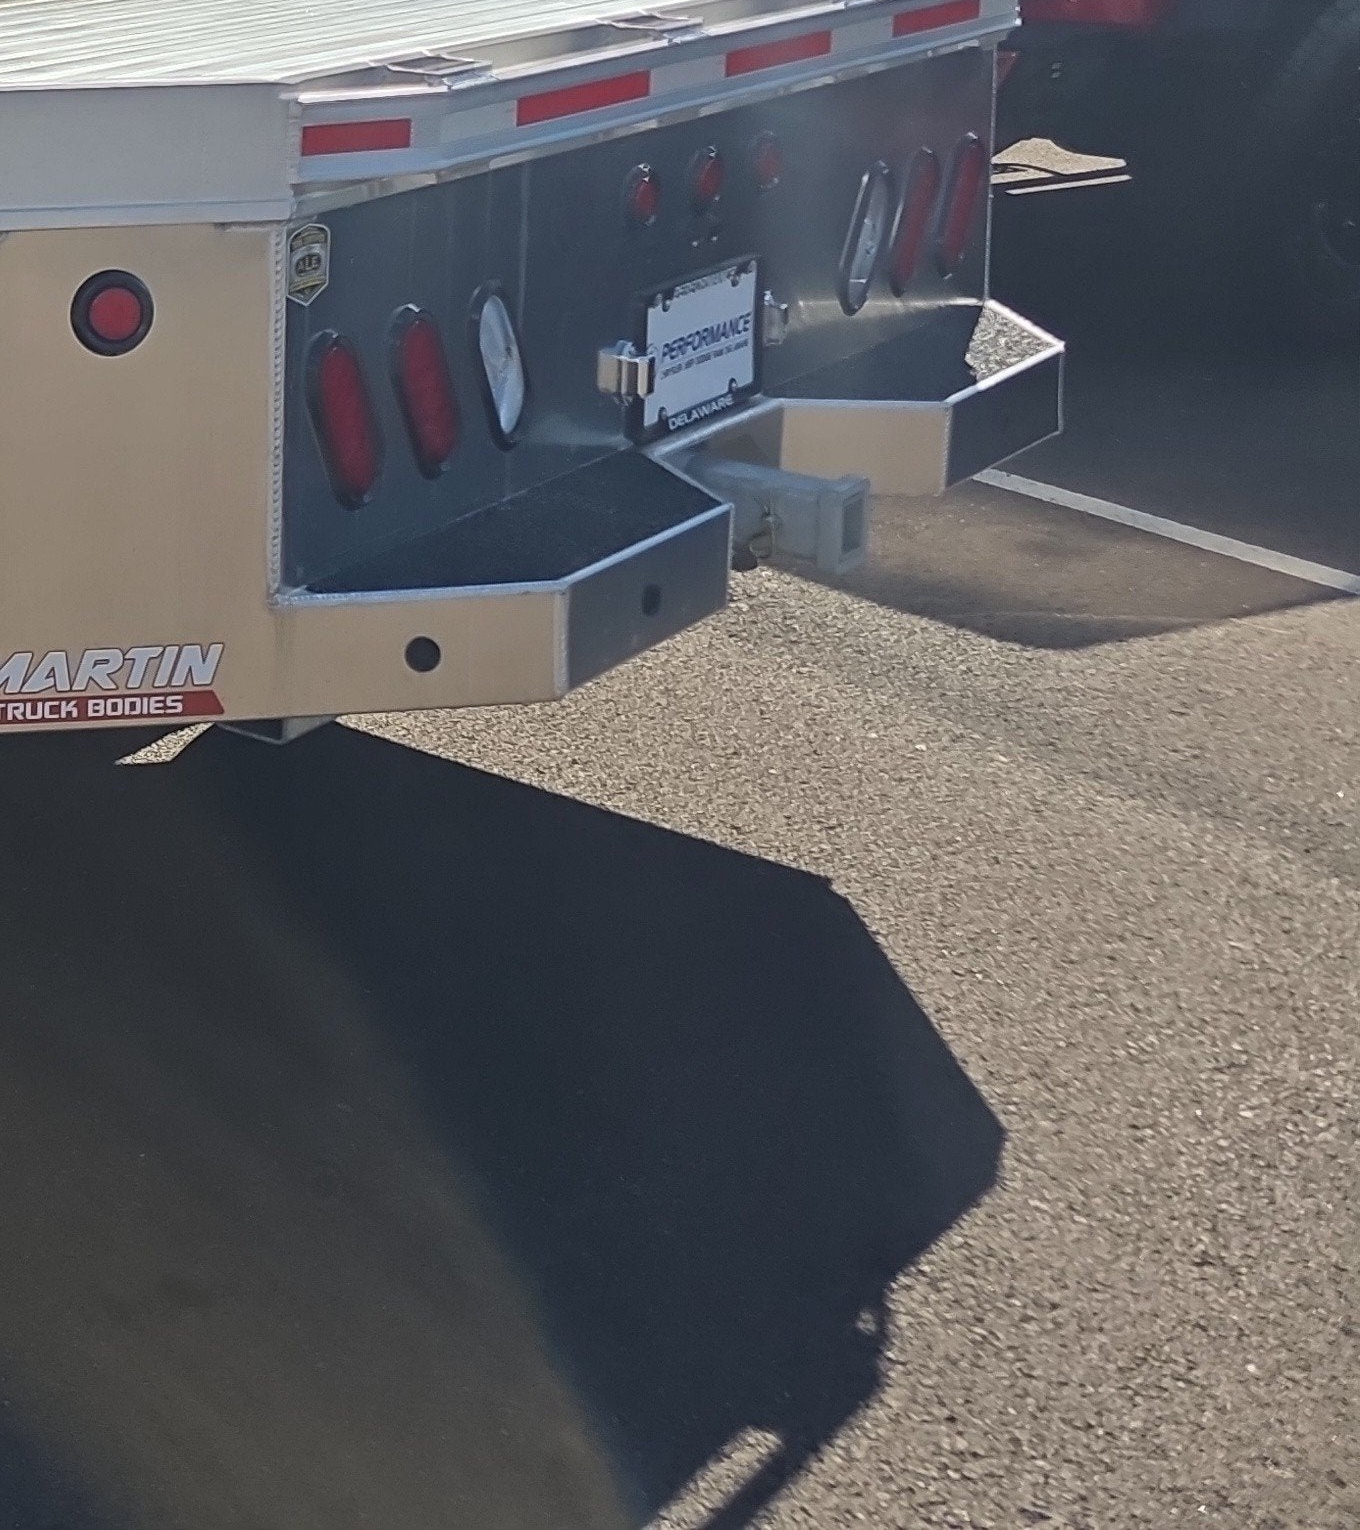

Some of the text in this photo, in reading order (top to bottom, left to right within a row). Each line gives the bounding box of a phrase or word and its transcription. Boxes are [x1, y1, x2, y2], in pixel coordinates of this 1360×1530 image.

[662, 311, 752, 361] PERFORMANCE
[668, 394, 735, 430] DELAWARE
[87, 695, 183, 718] BODIES
